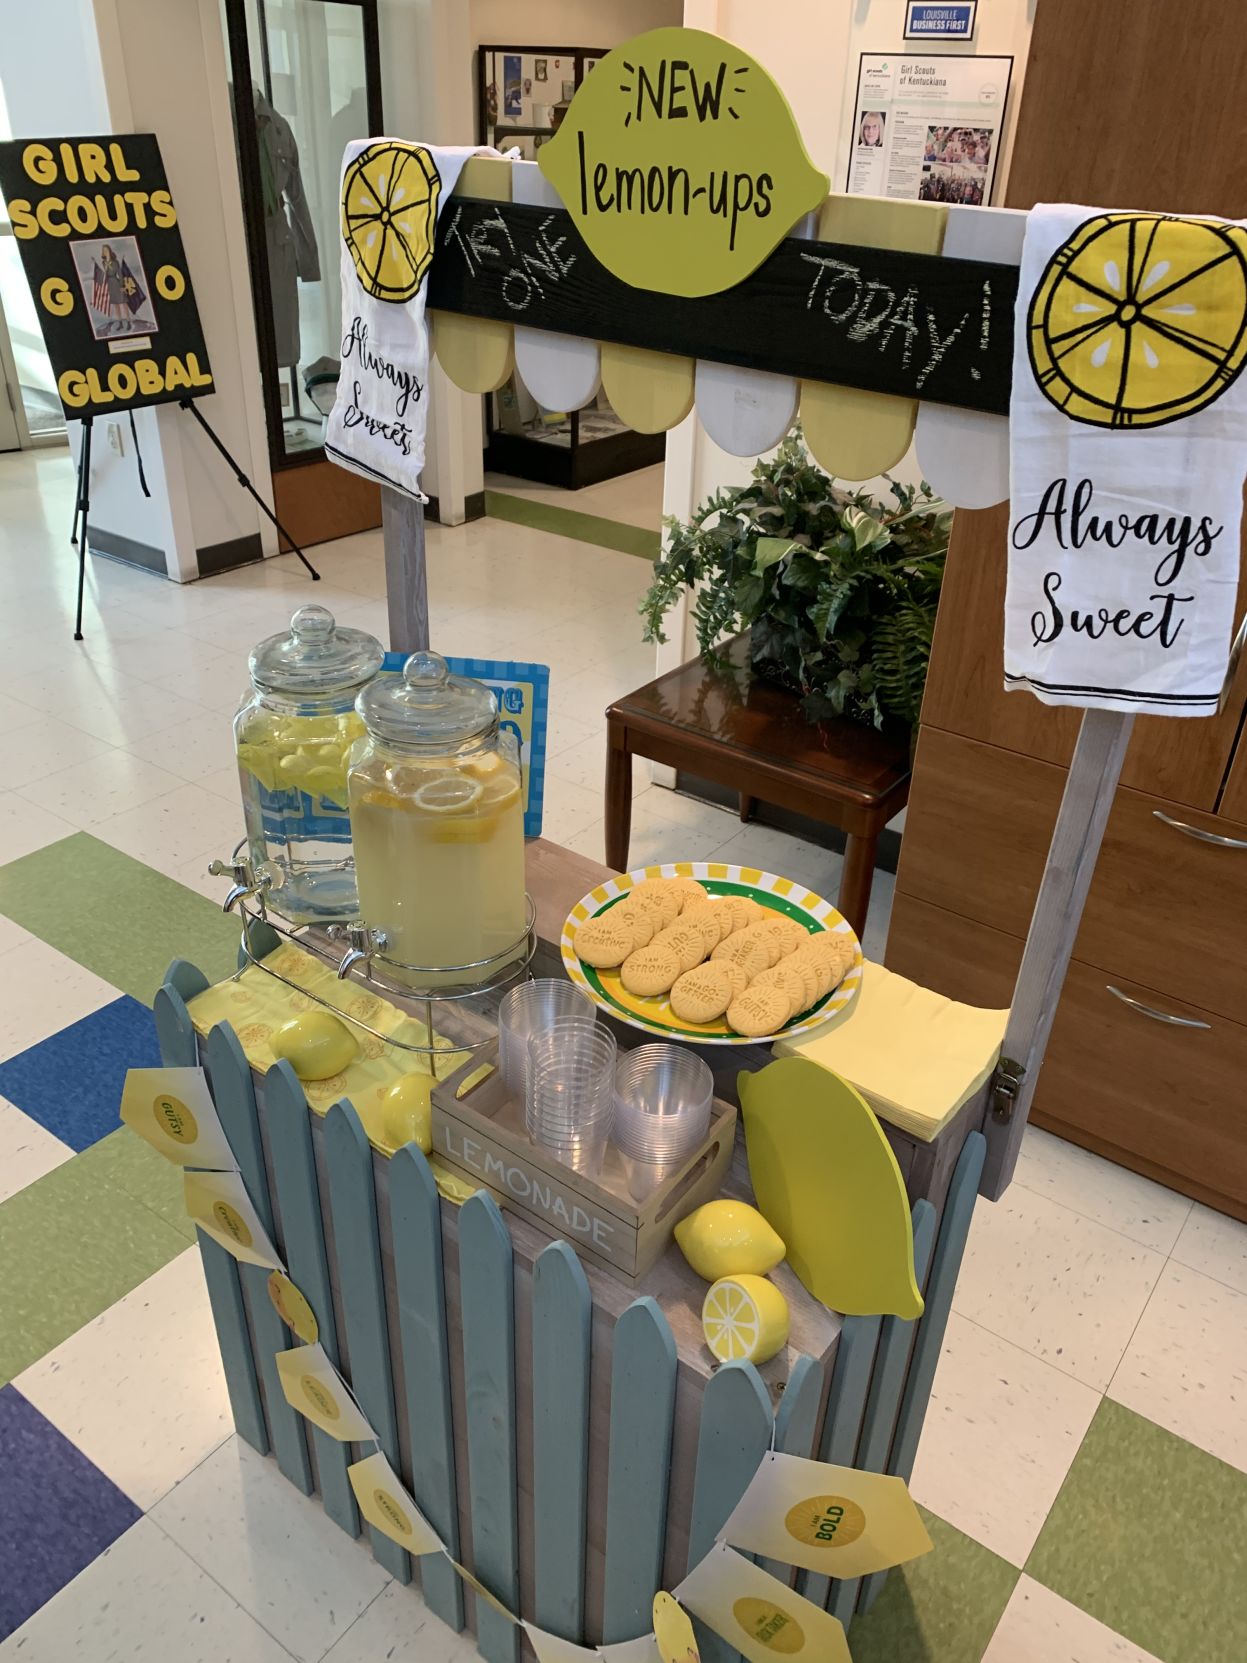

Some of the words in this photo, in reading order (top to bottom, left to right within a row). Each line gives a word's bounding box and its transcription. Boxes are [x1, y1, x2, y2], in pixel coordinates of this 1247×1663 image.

[912, 20, 945, 30] BUSINESS
[946, 20, 966, 30] FIRST
[923, 10, 957, 19] LOUISVILLE
[636, 59, 727, 122] NEW
[900, 76, 906, 85] of
[908, 76, 947, 86] Kentuckiana
[901, 65, 912, 74] Girl
[914, 65, 936, 75] Scouts
[22, 143, 140, 185] GIRL
[7, 190, 177, 240] SCOUTS
[577, 130, 773, 251] lemon-ups
[444, 205, 516, 278] TRY
[501, 214, 577, 310] ONE
[800, 252, 991, 389] TODAY!
[58, 352, 213, 407] GLOBAL
[342, 317, 423, 417] Always
[344, 381, 412, 455] Sweet
[1012, 478, 1224, 587] Always
[1031, 571, 1195, 648] Sweet
[628, 964, 672, 974] STRONG
[161, 1102, 184, 1137] GUTSY
[445, 1126, 615, 1252] LEMONADE
[814, 1505, 845, 1541] BOLD
